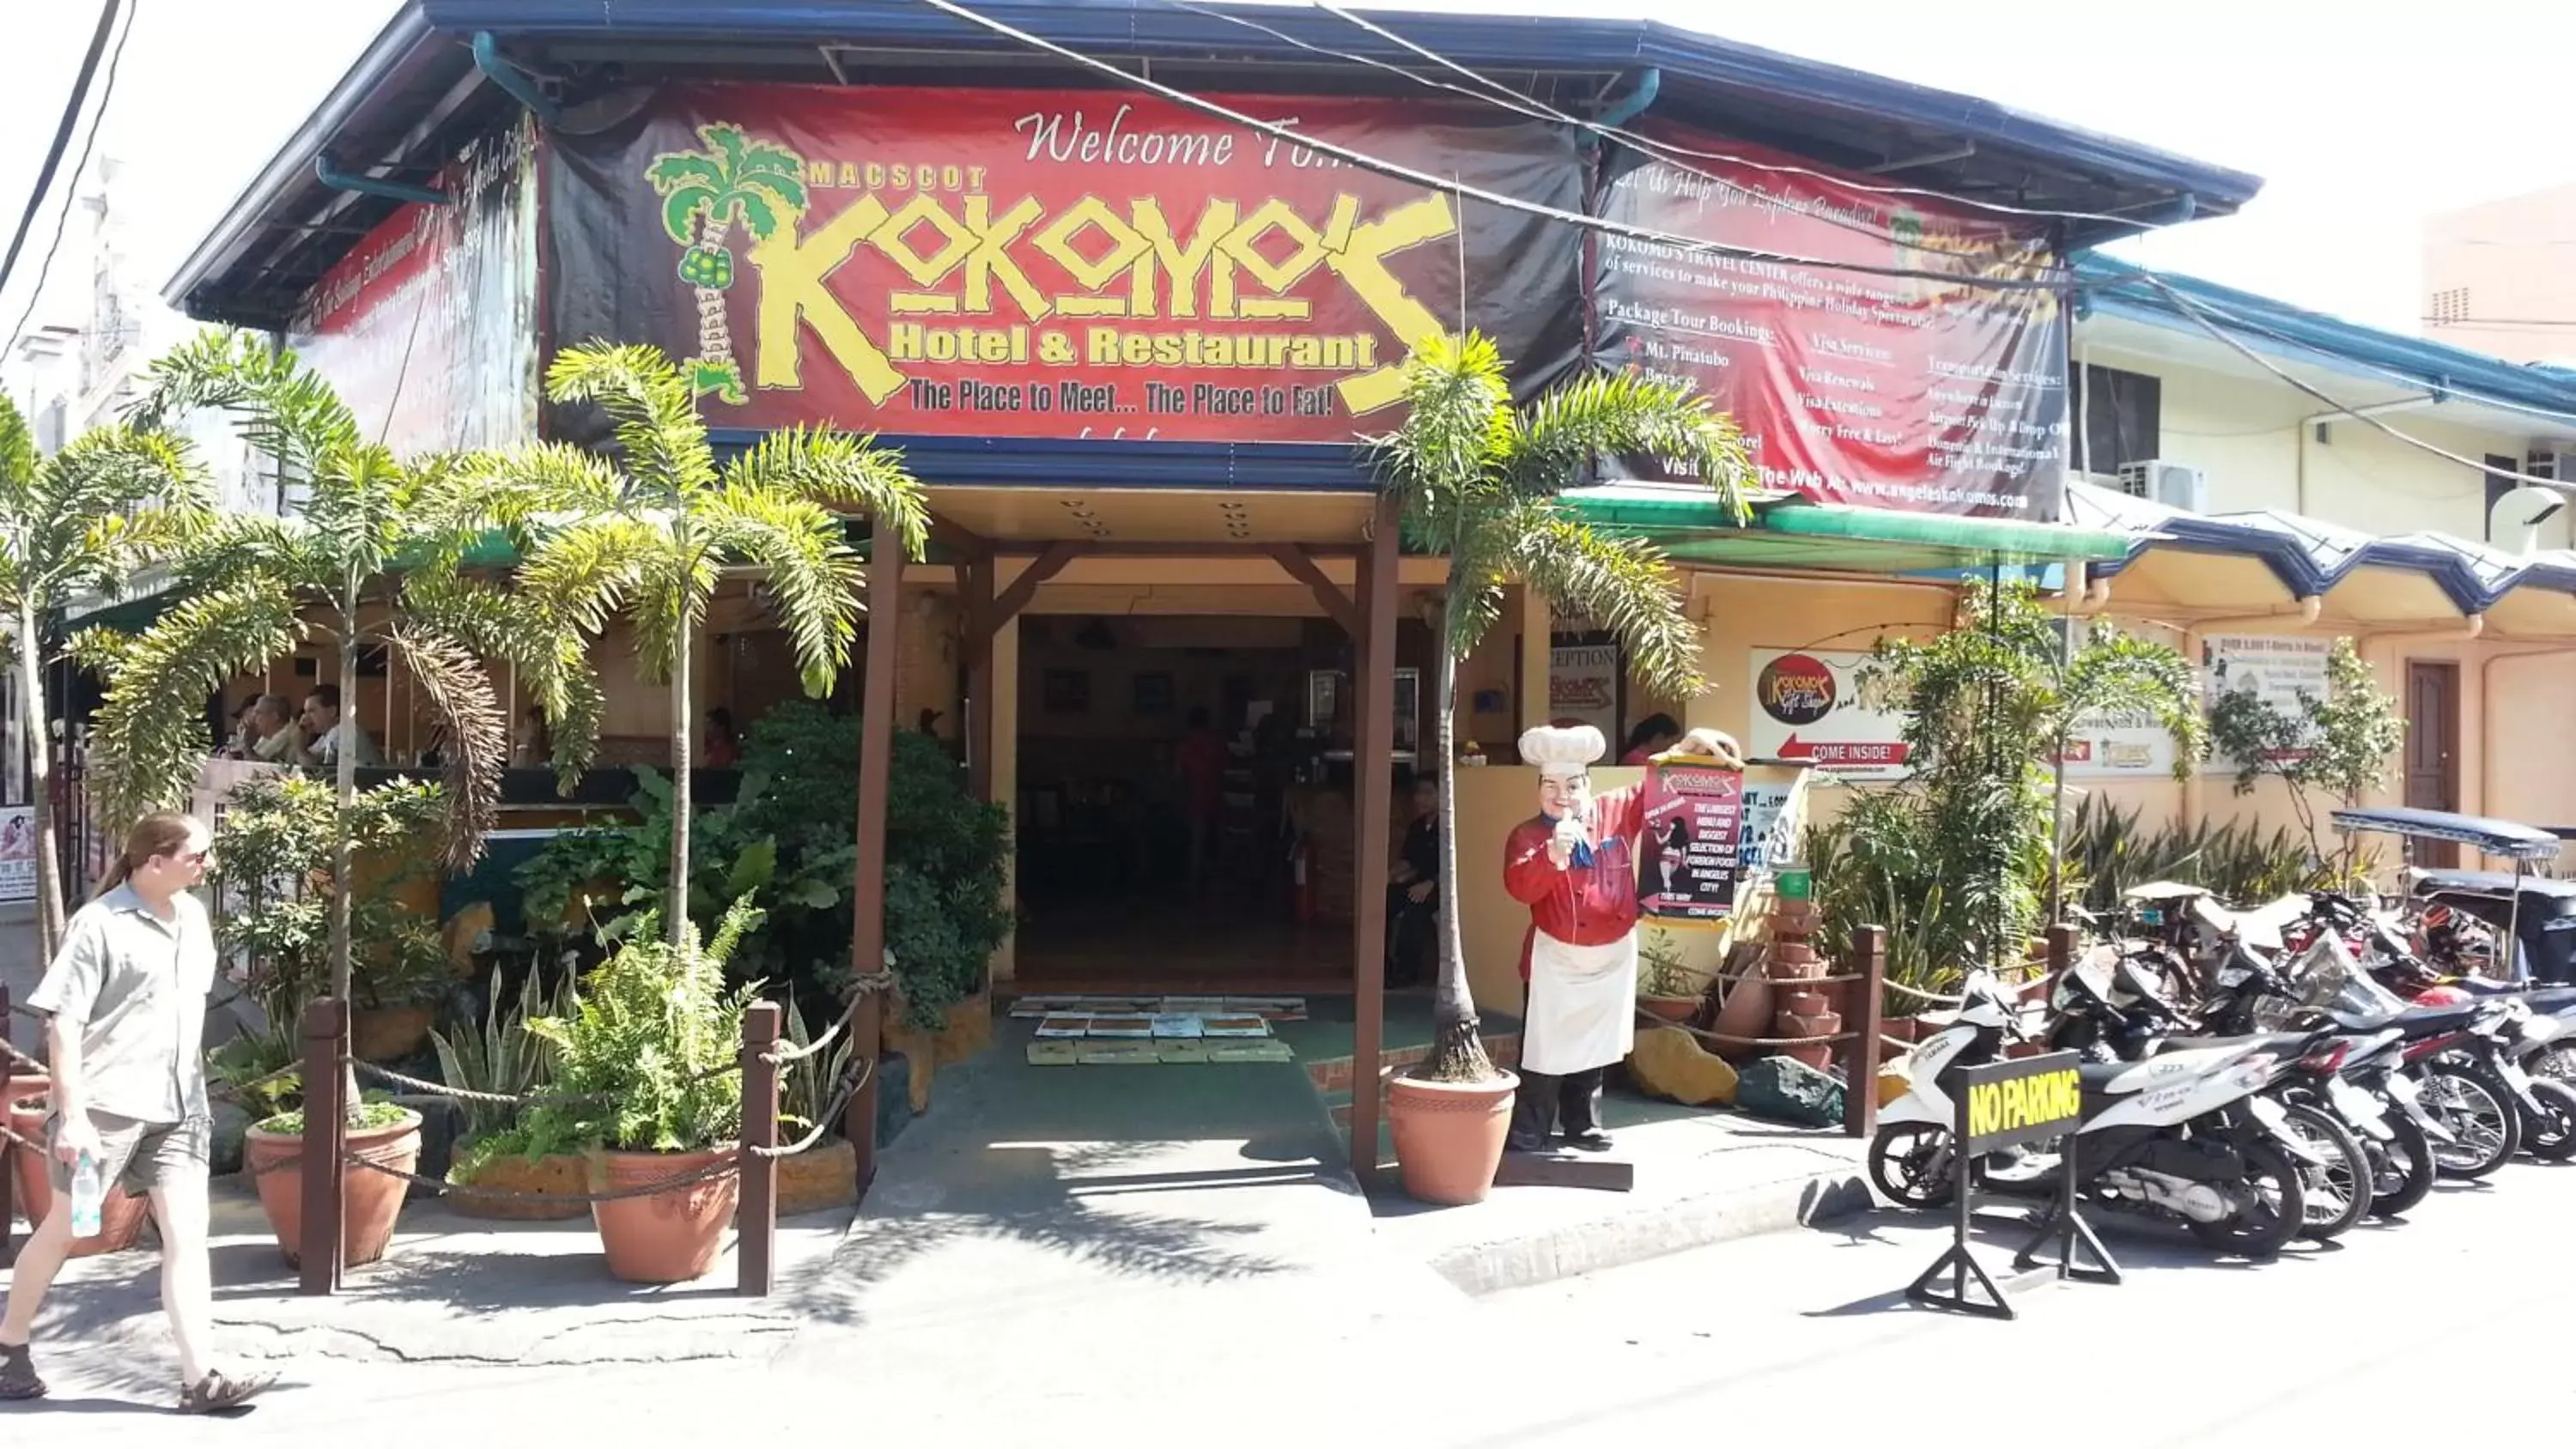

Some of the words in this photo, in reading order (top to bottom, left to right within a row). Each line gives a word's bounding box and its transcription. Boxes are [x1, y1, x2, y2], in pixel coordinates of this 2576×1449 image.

[1014, 104, 1233, 167] Welcome
[809, 163, 987, 192] MACSCOT
[1648, 166, 1670, 193] Us
[1674, 172, 1710, 214] Help
[1605, 253, 1620, 271] of
[1622, 260, 1675, 281] services
[1678, 268, 1692, 284] to
[1694, 271, 1728, 290] make
[1731, 281, 1760, 297] your
[1826, 296, 1869, 318] Holiday
[1688, 251, 1735, 272] TRAVEL
[1740, 258, 1788, 283] CENTER
[1790, 271, 1825, 291] offers
[747, 191, 1458, 415] KOKOMO'S
[1608, 298, 1670, 328] Package
[1671, 307, 1706, 330] Tour
[1709, 314, 1775, 343] Bookings:
[888, 323, 1030, 365] Hotel
[1038, 324, 1078, 367] &
[1087, 330, 1378, 371] Restaurant
[1672, 345, 1729, 367] Pinatubo
[910, 379, 951, 411] The
[957, 379, 1023, 412] Place
[1029, 381, 1054, 412] to
[1059, 381, 1138, 414] Meet...
[1145, 382, 1186, 414] The
[1191, 382, 1255, 415] Place
[1261, 383, 1285, 415] to
[1291, 383, 1334, 417] Eat!
[1662, 457, 1700, 477] Visit
[1789, 469, 1823, 488] Web
[1812, 744, 1846, 761] COME
[1848, 744, 1892, 761] INSIDE!
[1662, 773, 1737, 797] KOKOMO'S
[1968, 1082, 2002, 1138] NO
[2002, 1067, 2081, 1131] PARKING
